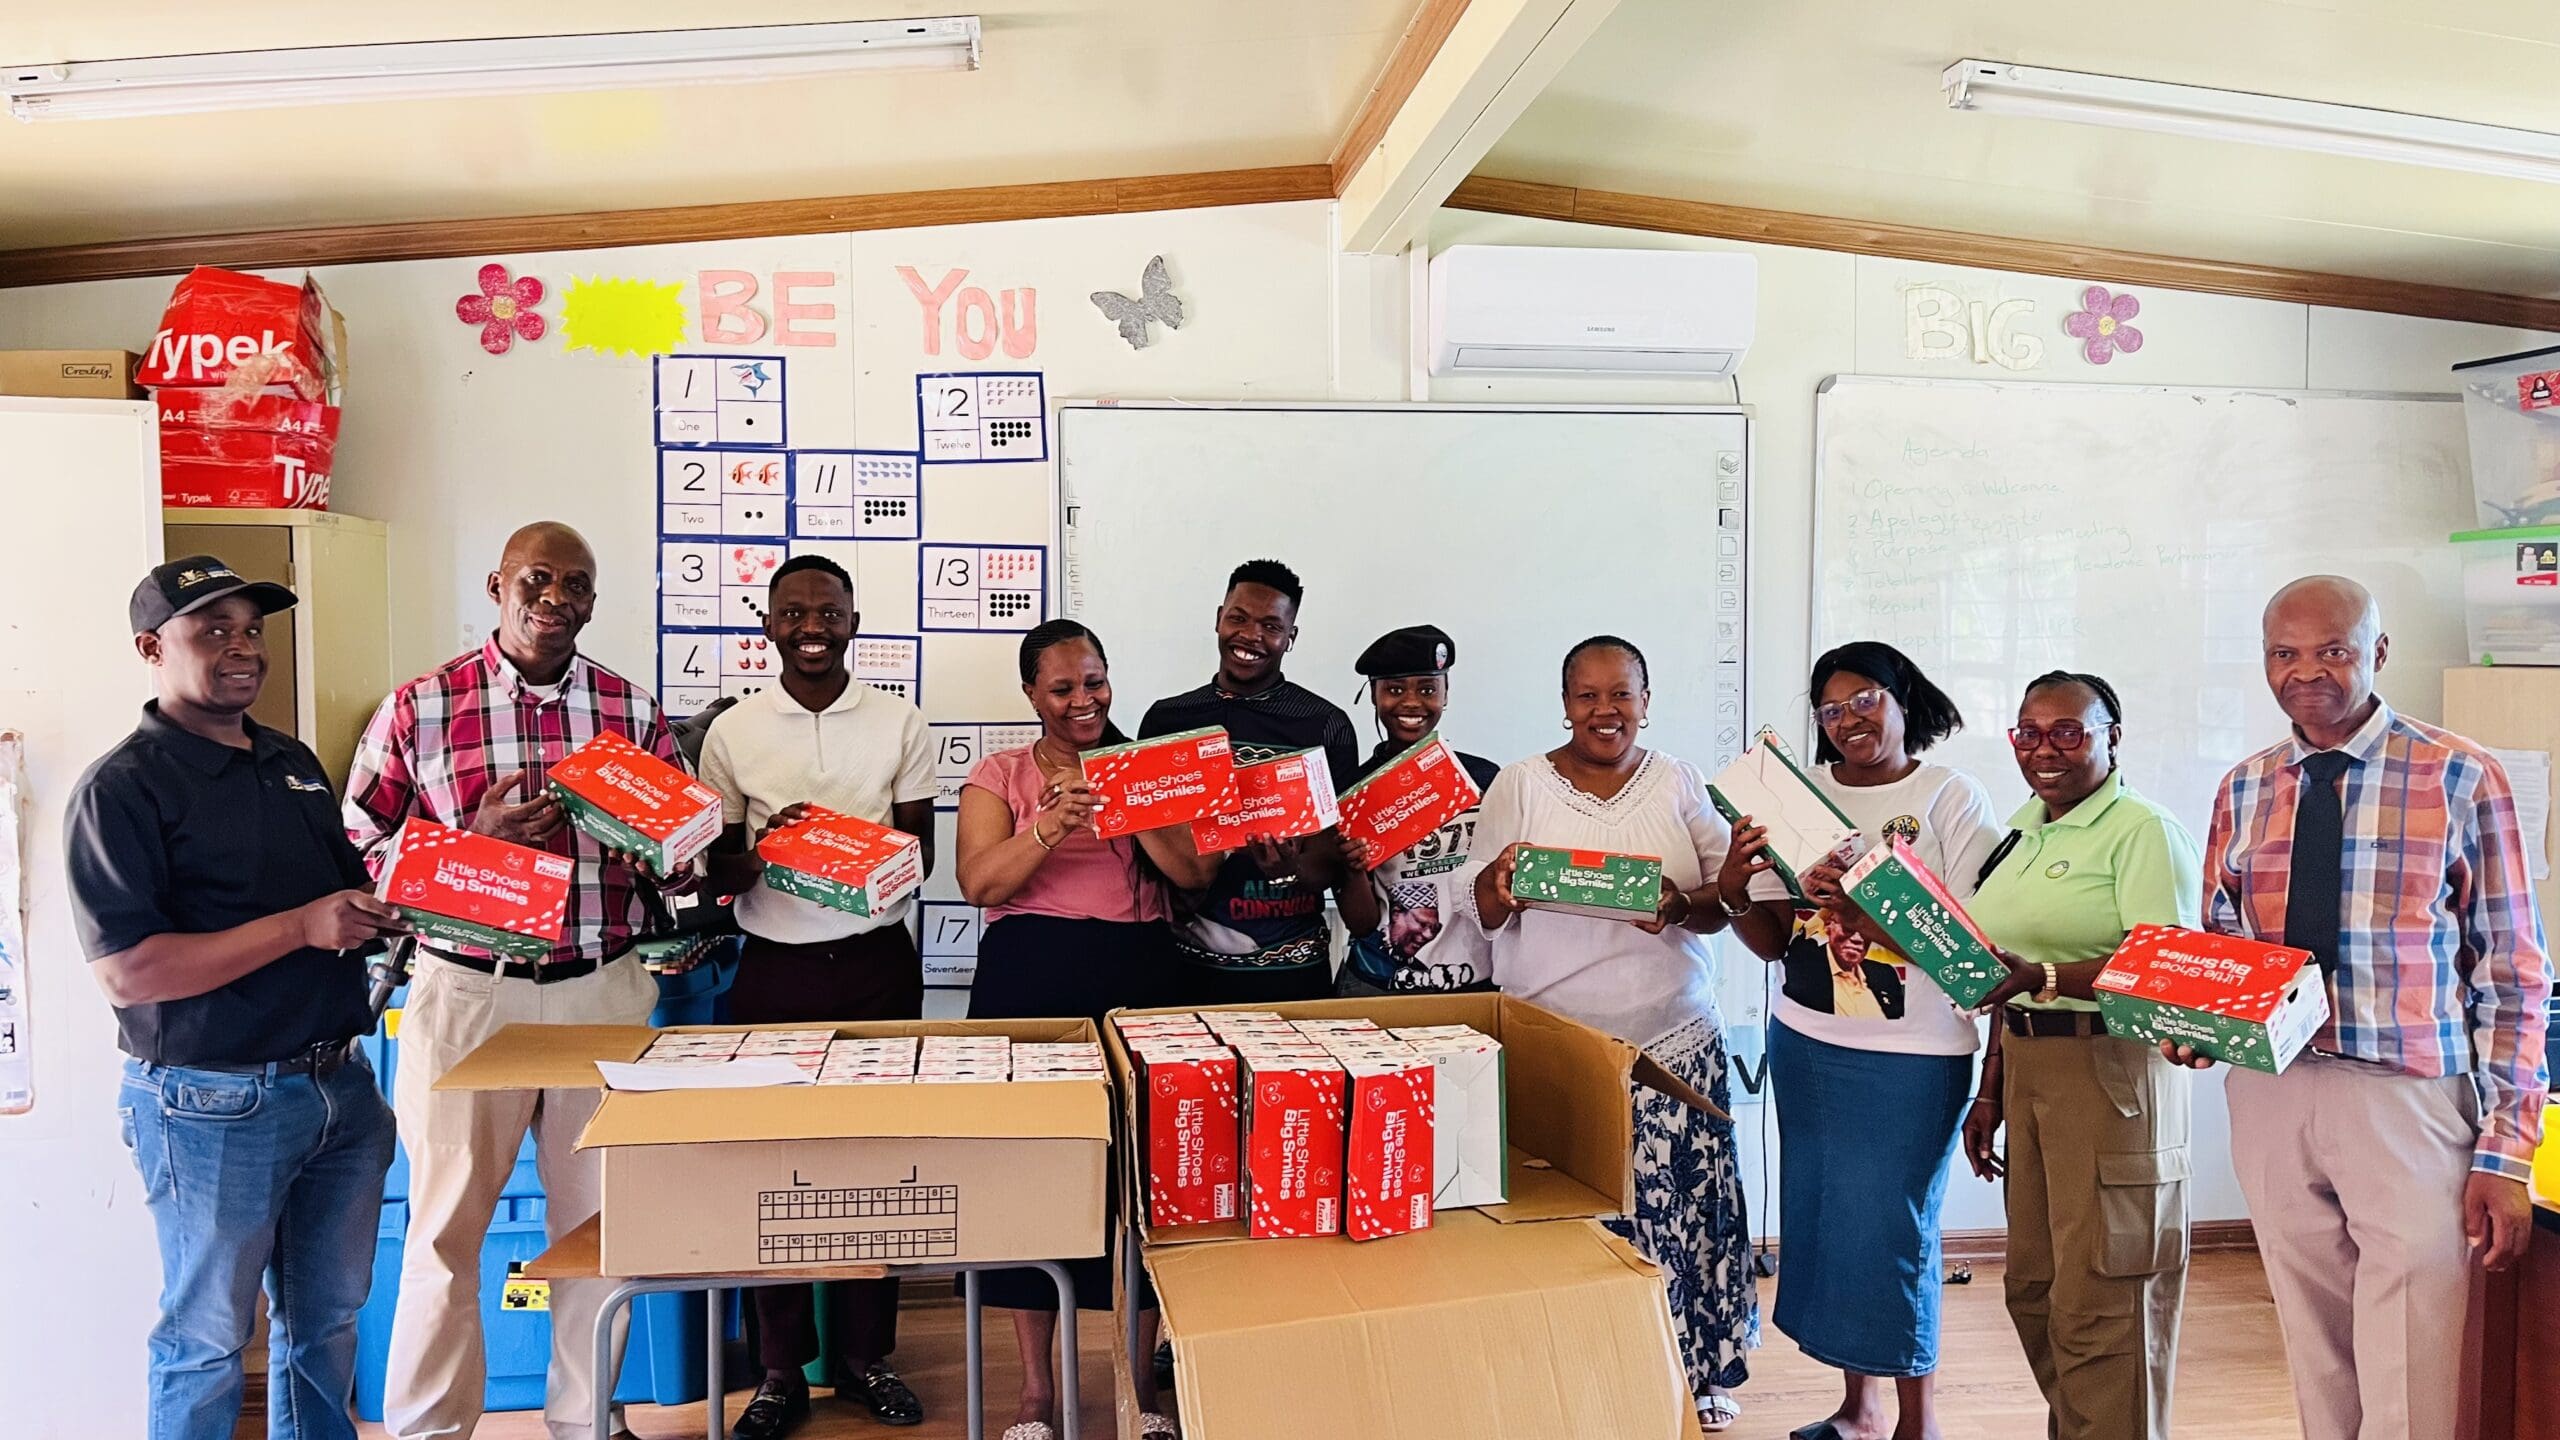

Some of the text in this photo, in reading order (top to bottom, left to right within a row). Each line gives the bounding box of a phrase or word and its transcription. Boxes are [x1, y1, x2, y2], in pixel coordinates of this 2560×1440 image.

[699, 266, 1037, 360] BE YOU
[1905, 286, 2044, 370] BIG
[148, 328, 294, 380] Typek
[65, 366, 108, 379] Croxley
[161, 410, 185, 421] A4
[936, 388, 970, 417] 12
[278, 417, 301, 432] A4
[678, 420, 700, 432] One
[934, 438, 971, 450] Twelve
[683, 462, 705, 491] 2
[815, 464, 837, 494] 11
[181, 493, 212, 504] Typek
[681, 513, 704, 524] Two
[808, 514, 843, 527] Eleven
[682, 554, 704, 583] 3
[936, 557, 970, 586] 13
[675, 604, 708, 616] Three
[927, 607, 975, 620] Thirteen
[683, 645, 704, 678] 4
[679, 695, 704, 706] Four
[938, 736, 971, 765] 15
[595, 768, 661, 810] Big Smiles
[604, 760, 672, 801] Little Shoes
[1123, 770, 1203, 796] Little Shoes
[1126, 783, 1206, 807] Big Smiles
[1243, 793, 1282, 810] Shoes
[1368, 782, 1432, 825] Little Shoes
[1217, 805, 1286, 827] Big Smiles
[1374, 792, 1440, 834] Big Smiles
[801, 833, 862, 856] Big Smiles
[809, 826, 871, 849] Little Shoes
[437, 858, 530, 890] Little Shoes
[1424, 866, 1450, 875] WORK
[1558, 876, 1614, 890] Big Smiles
[1559, 867, 1615, 881] Little Shoes
[434, 870, 528, 906] Big Smiles
[936, 916, 970, 944] 17
[1905, 909, 1952, 958] Big Smiles
[1912, 902, 1960, 951] Little Shoes
[924, 963, 975, 974] Seventeen
[2149, 961, 2246, 987] Little Shoes
[2156, 948, 2253, 976] Big Smiles
[2151, 1019, 2219, 1043] Big Smiles
[2177, 1019, 2215, 1034] Shoes
[1175, 1099, 1191, 1188] Big Smiles
[1191, 1099, 1204, 1187] Little Shoes
[1280, 1109, 1297, 1201] Big Smiles
[1295, 1109, 1310, 1198] Little Shoes
[1380, 1111, 1396, 1201] Big Smiles
[1393, 1109, 1407, 1198] Little Shoes
[763, 1194, 770, 1203] 2
[792, 1193, 798, 1202] 3
[876, 1191, 882, 1199] 6
[904, 1190, 910, 1198] 7
[932, 1189, 938, 1197] 8
[763, 1233, 907, 1246] 9 10 11 12 13 1
